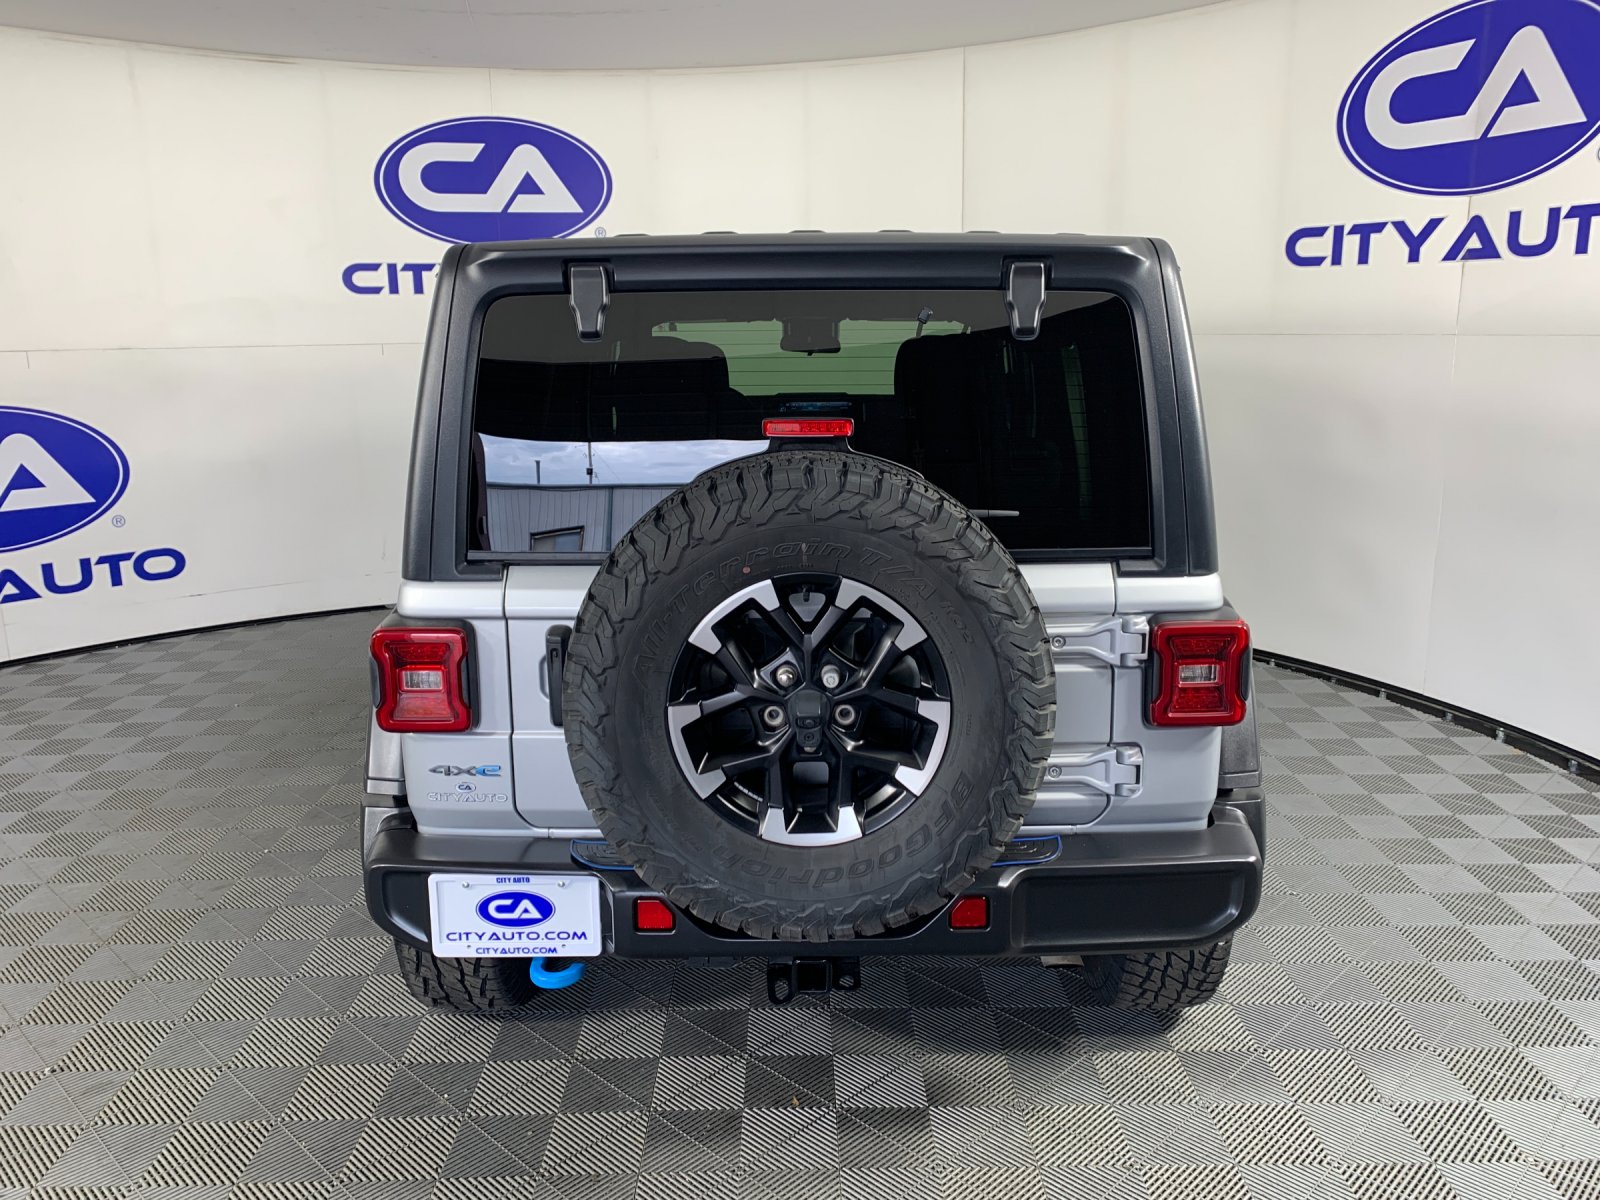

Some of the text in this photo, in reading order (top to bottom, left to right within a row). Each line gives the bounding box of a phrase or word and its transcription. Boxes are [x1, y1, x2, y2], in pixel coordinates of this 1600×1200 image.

[1364, 25, 1588, 150] CA
[398, 142, 584, 213] CA
[1285, 203, 1600, 267] CITYAUT
[341, 262, 440, 295] CIT
[496, 877, 512, 885] CITY
[487, 898, 545, 920] CA
[446, 931, 588, 942] CITYAUTO.COM
[475, 946, 558, 955] CITYAUTO.COM
